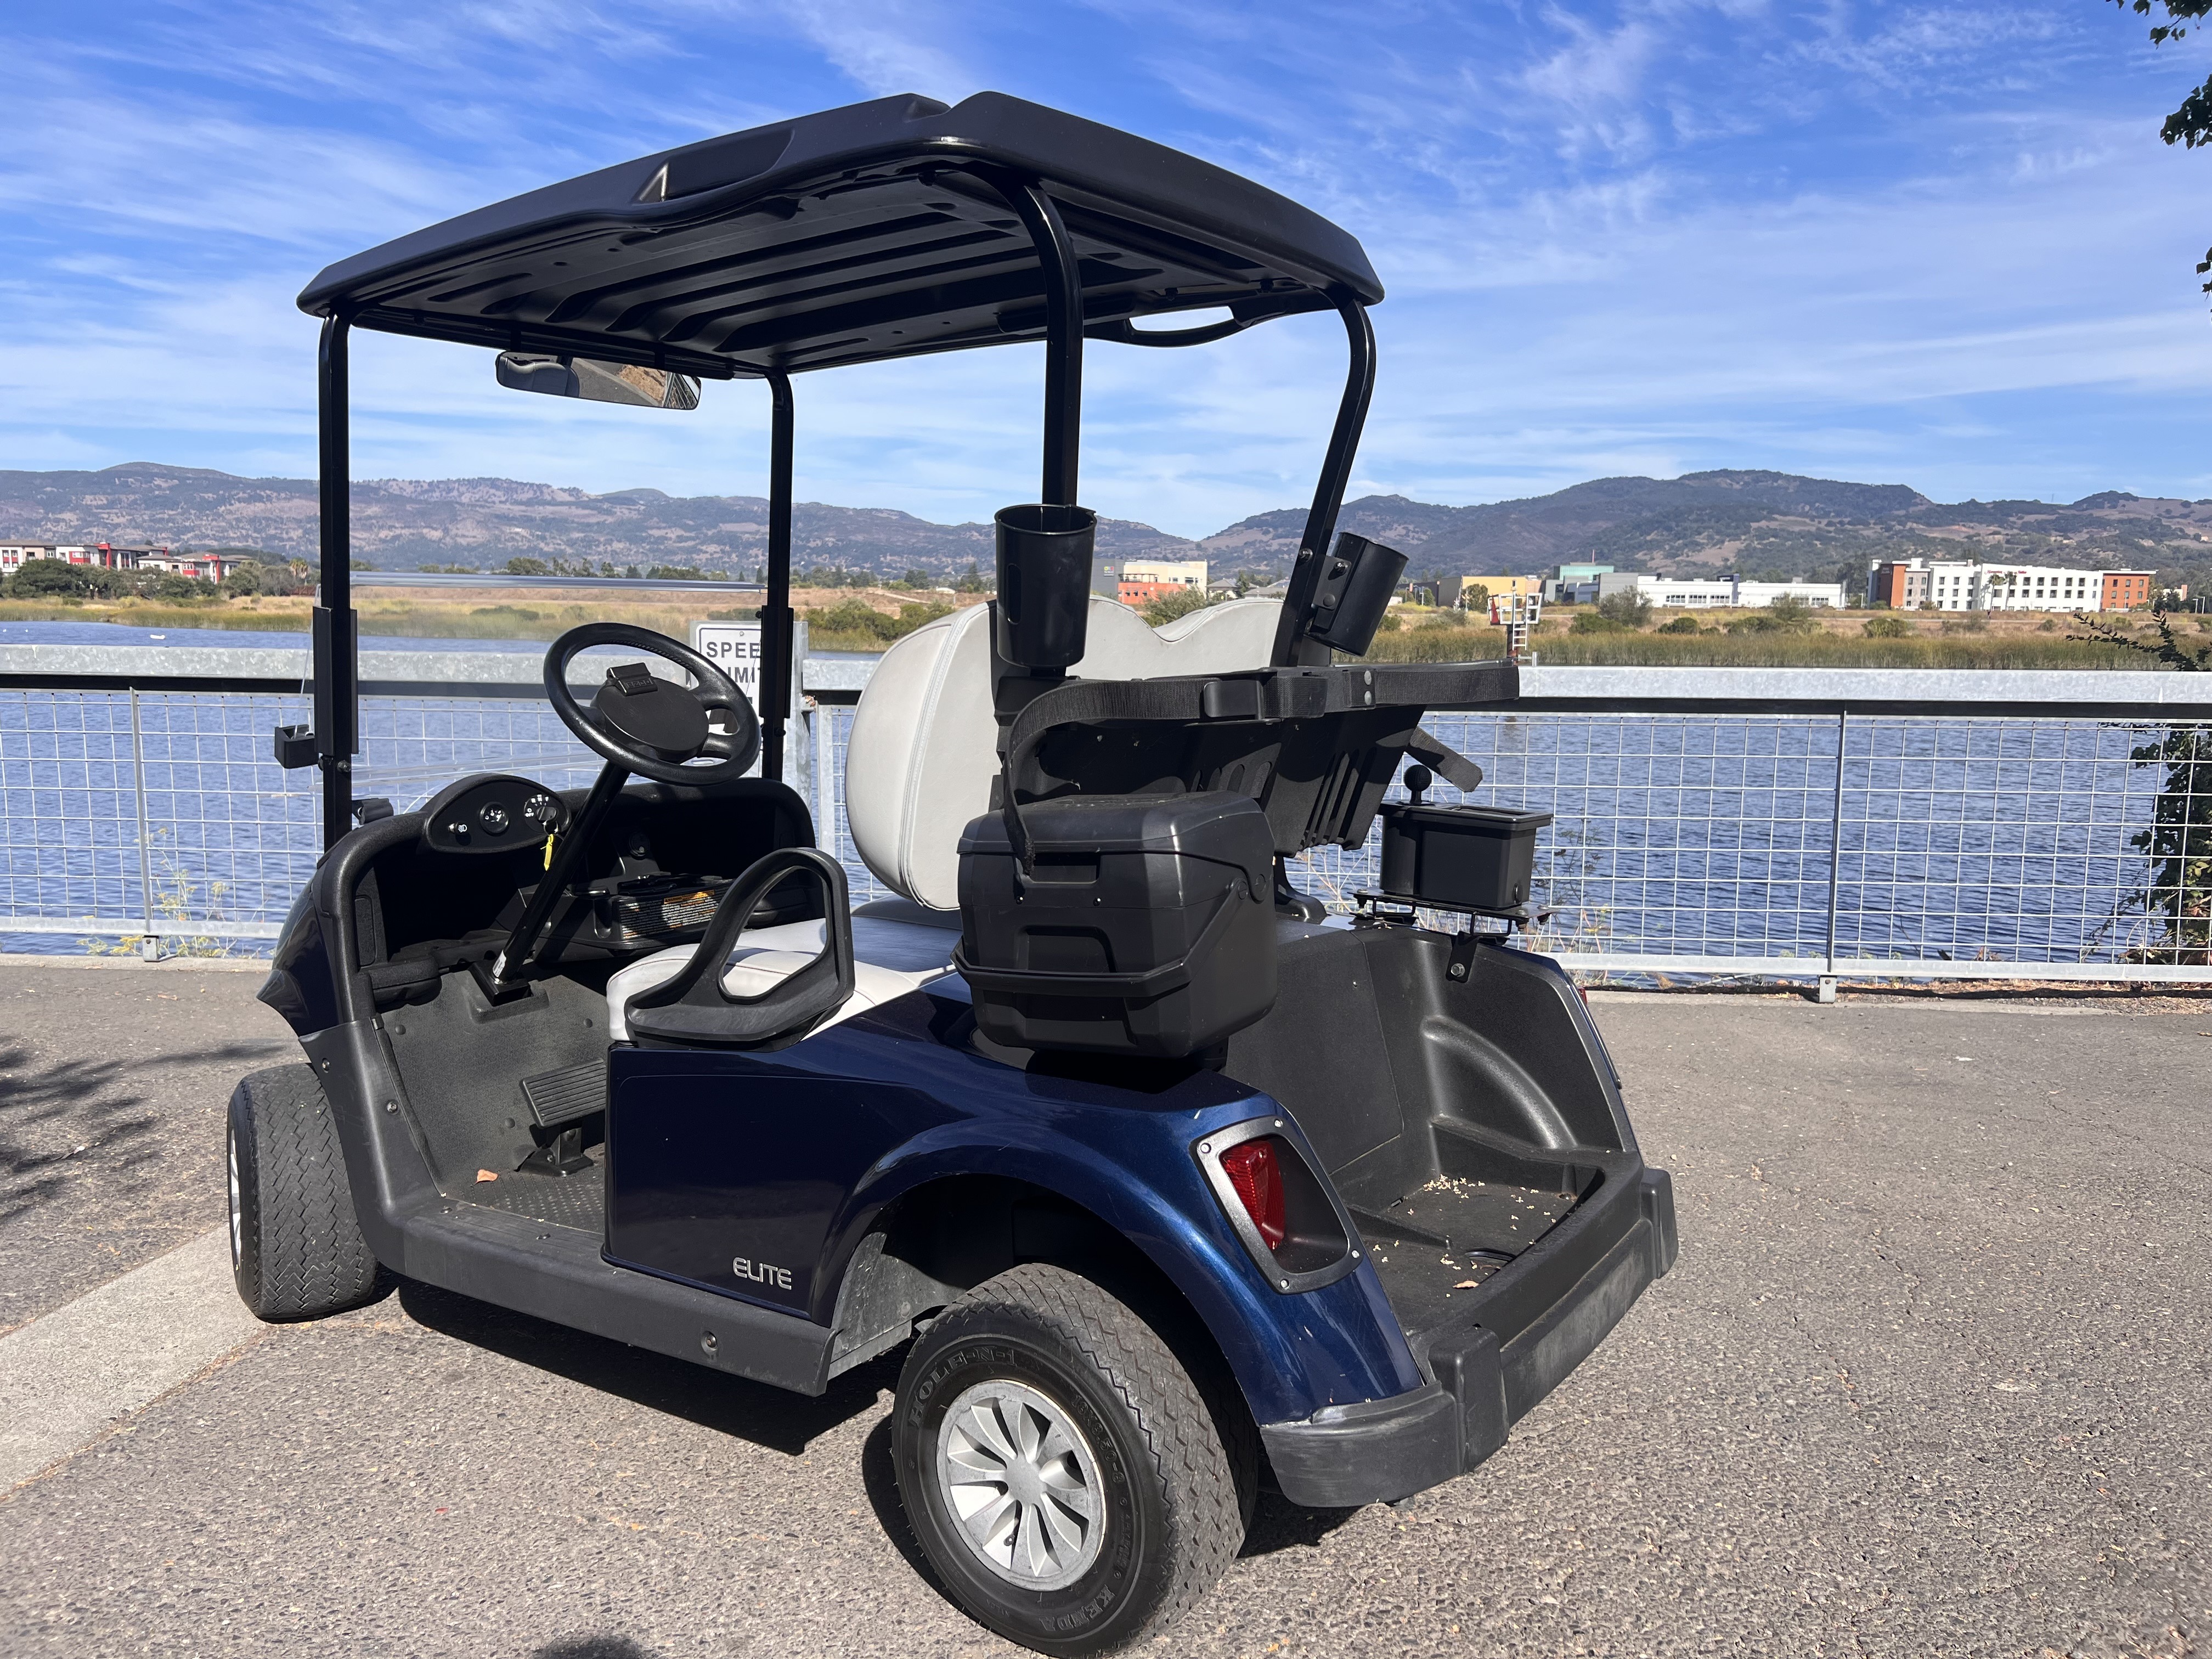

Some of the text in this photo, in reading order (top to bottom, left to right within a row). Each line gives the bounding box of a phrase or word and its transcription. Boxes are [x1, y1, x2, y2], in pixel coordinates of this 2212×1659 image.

[706, 641, 761, 659] SPEE
[727, 667, 761, 683] IMI
[733, 1257, 792, 1290] ELITE
[909, 1346, 1018, 1428] HOLE-N-1
[1039, 1584, 1115, 1632] KENDA
